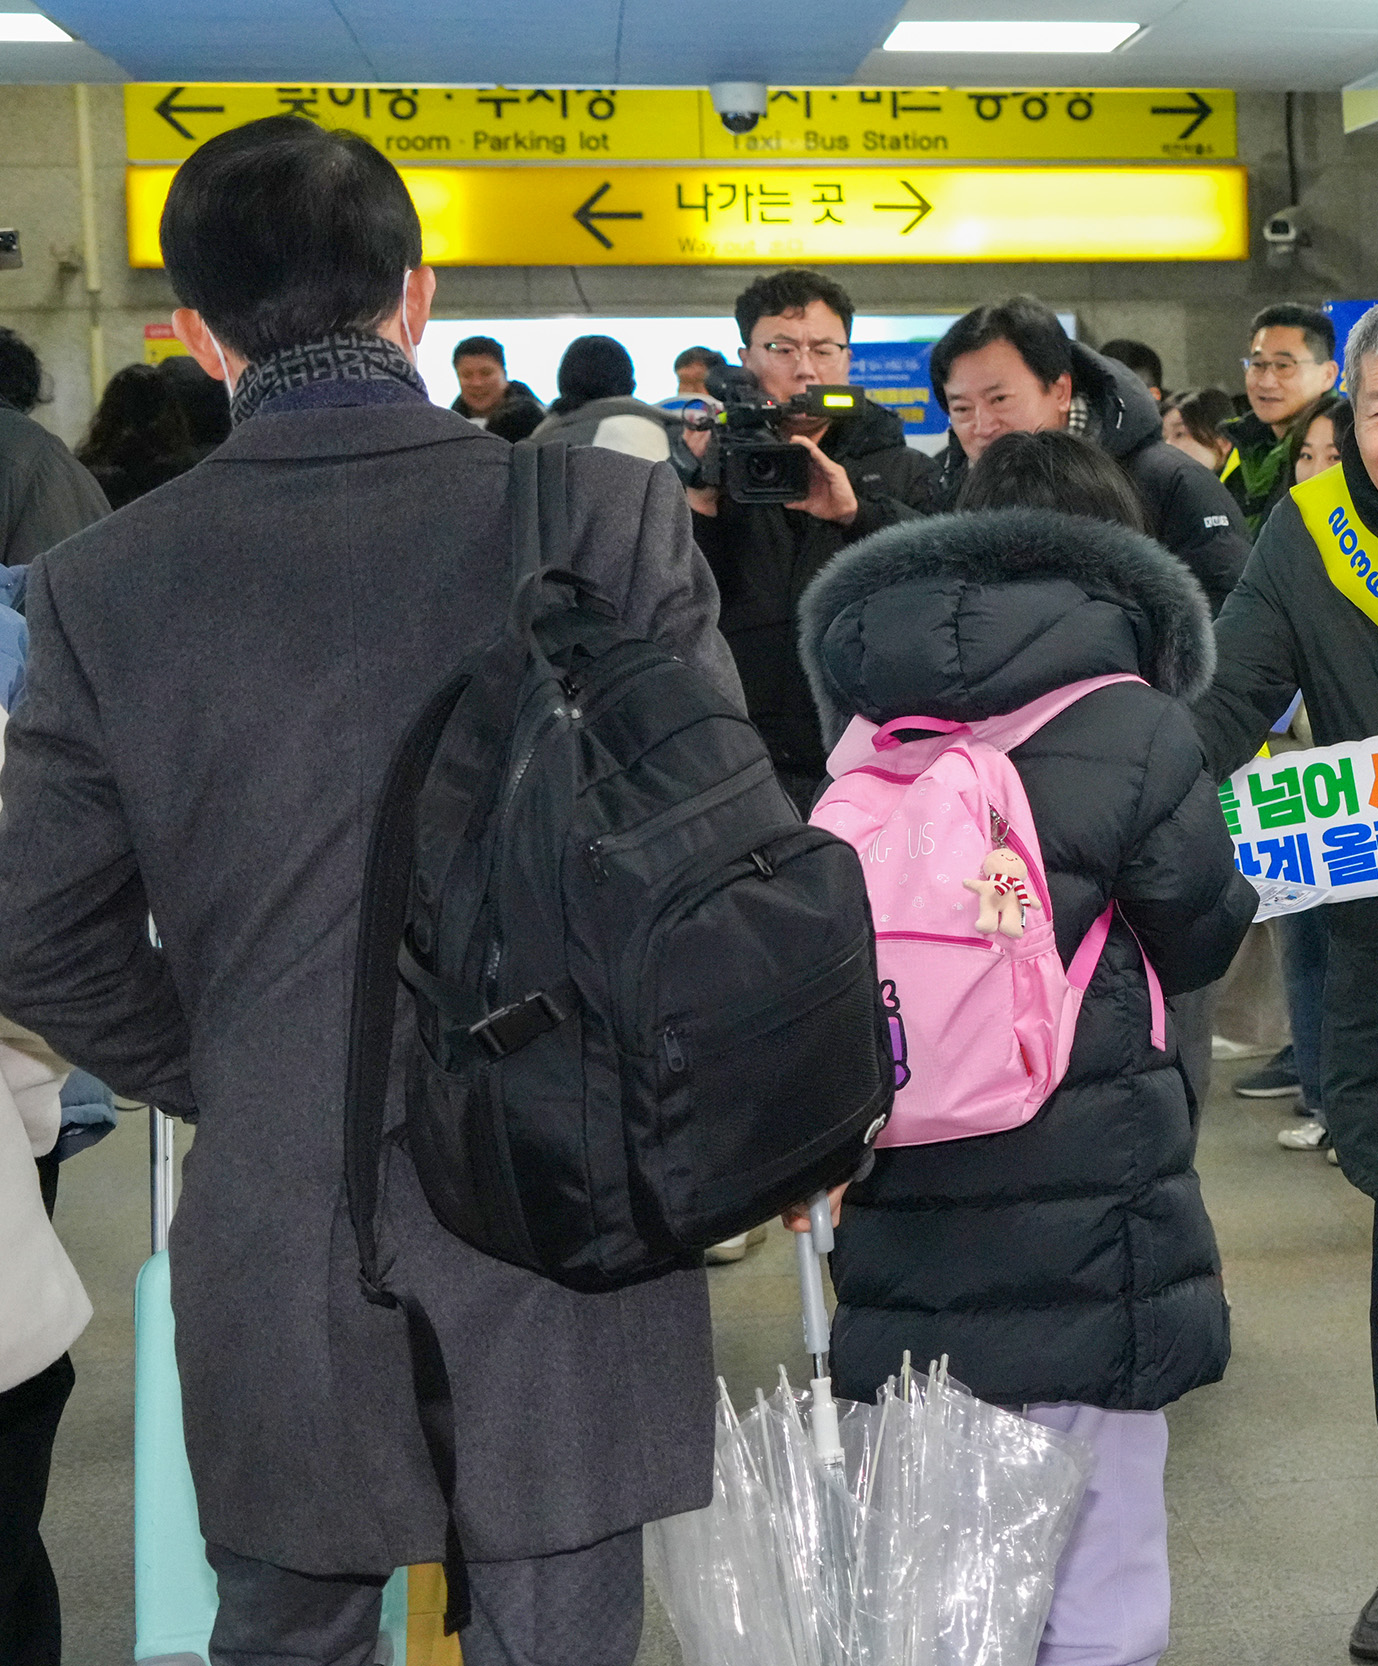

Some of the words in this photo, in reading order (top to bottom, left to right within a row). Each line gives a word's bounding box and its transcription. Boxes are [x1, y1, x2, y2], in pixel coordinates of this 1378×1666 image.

[386, 135, 449, 150] room
[474, 131, 566, 154] Parking
[580, 131, 609, 150] lot
[805, 131, 849, 150] Bus
[863, 131, 948, 150] Station
[677, 184, 791, 222] 나가는
[812, 184, 844, 223] 곳
[1247, 757, 1360, 830] 넘어
[908, 822, 936, 859] US
